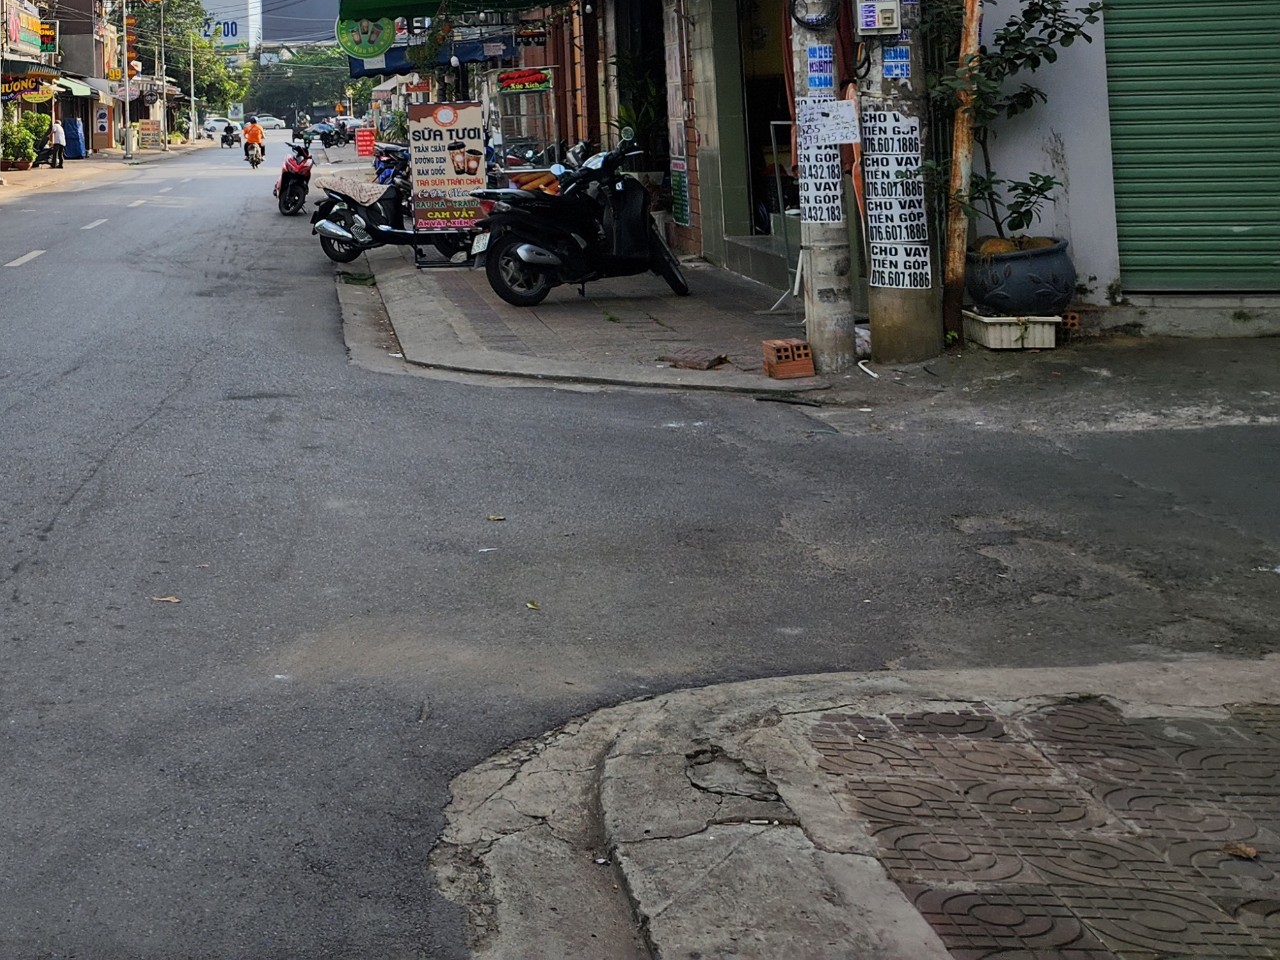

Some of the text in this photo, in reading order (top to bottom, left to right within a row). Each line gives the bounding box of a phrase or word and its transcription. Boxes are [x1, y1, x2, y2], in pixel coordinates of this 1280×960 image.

[862, 113, 887, 123] CHO
[412, 127, 481, 141] SỮA TƯƠI
[815, 151, 839, 162] GÓP
[865, 156, 920, 167] CHO VAY
[814, 182, 838, 191] VAY
[814, 193, 839, 204] GÓP
[867, 199, 923, 211] CHO VAY
[899, 211, 924, 223] GÓP
[871, 246, 928, 257] CHO VAY
[904, 259, 928, 270] GÓP
[872, 270, 930, 287] 076.607.1886
